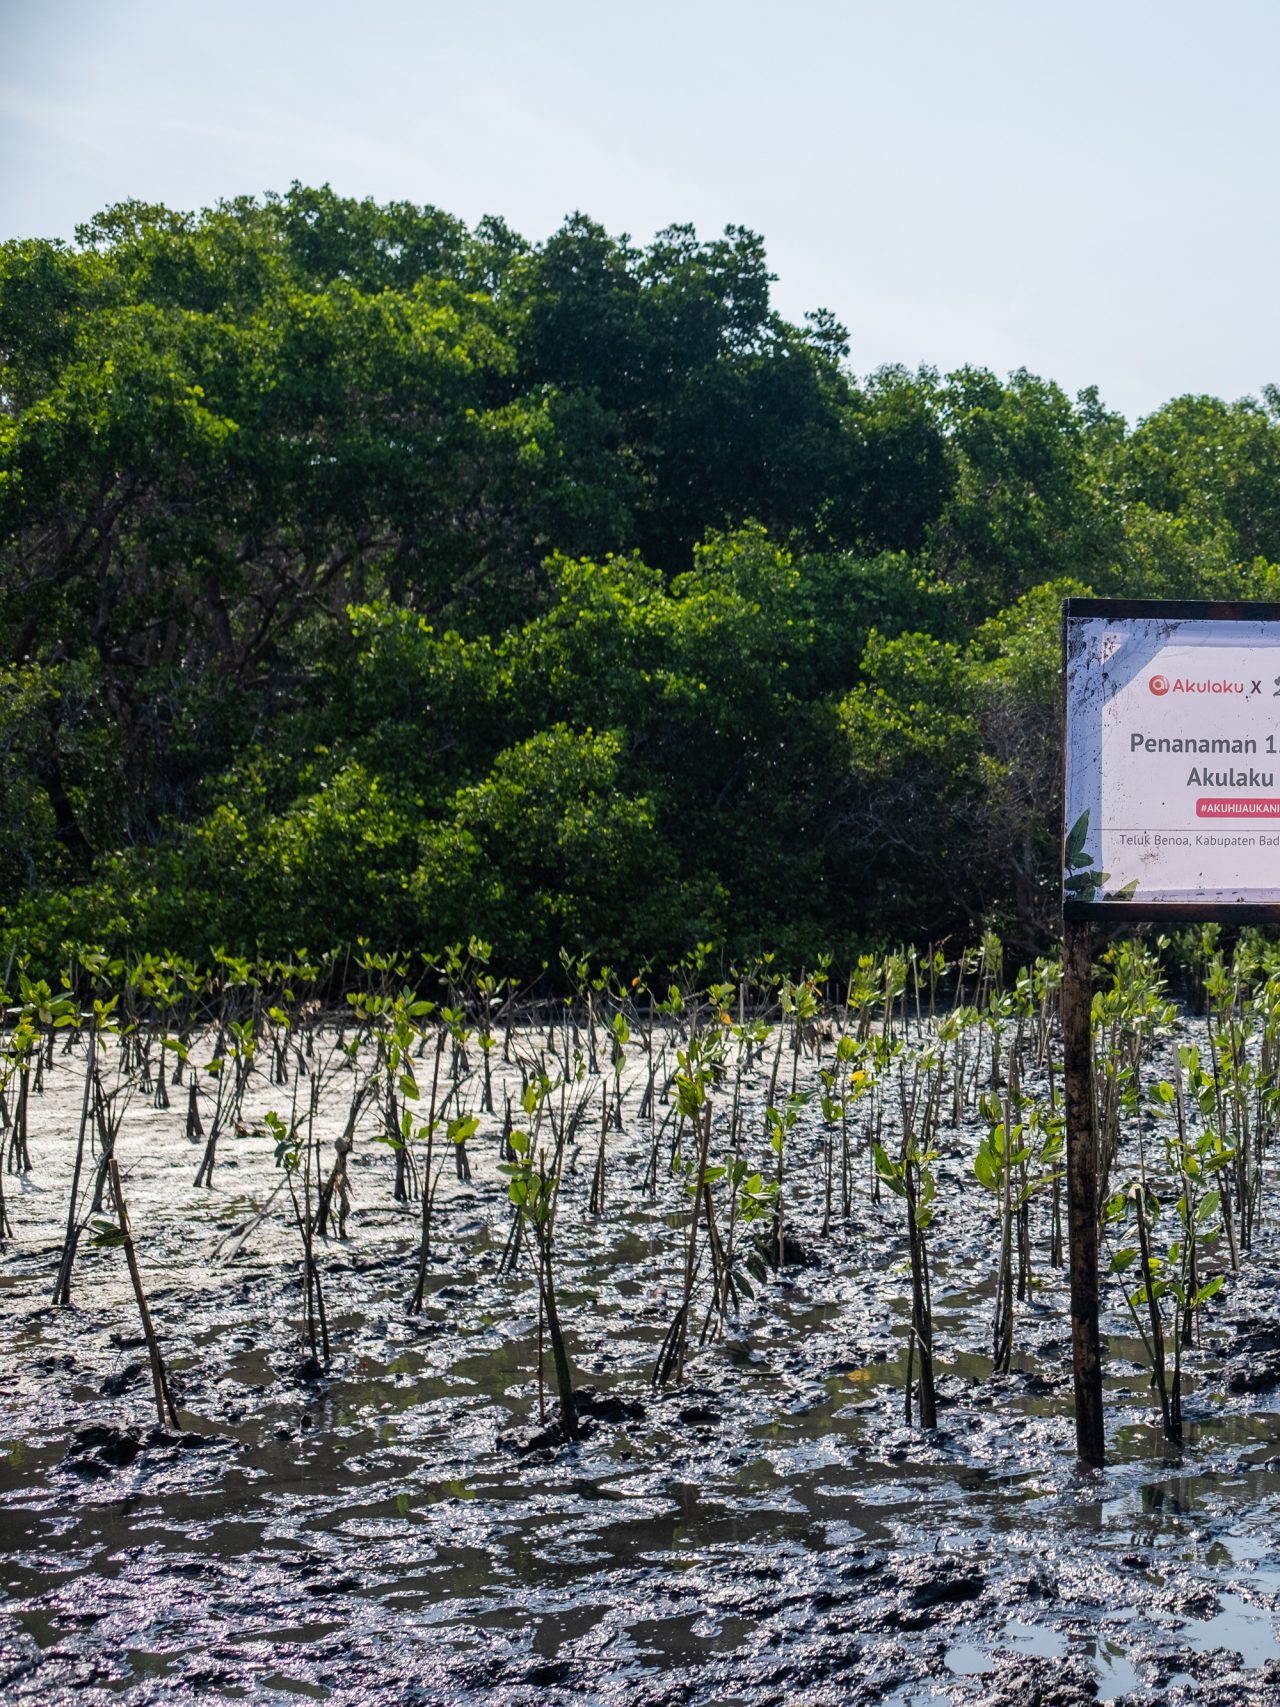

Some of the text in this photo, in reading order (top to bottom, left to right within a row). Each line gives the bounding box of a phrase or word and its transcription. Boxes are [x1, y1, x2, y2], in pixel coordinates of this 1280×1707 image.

[1172, 678, 1244, 694] Akulaku
[1130, 733, 1257, 753] Penanaman
[1186, 768, 1274, 787] Akulaku
[1120, 834, 1150, 846] Teluk
[1154, 834, 1192, 847] Benoa,
[1195, 835, 1255, 847] Kabupaten
